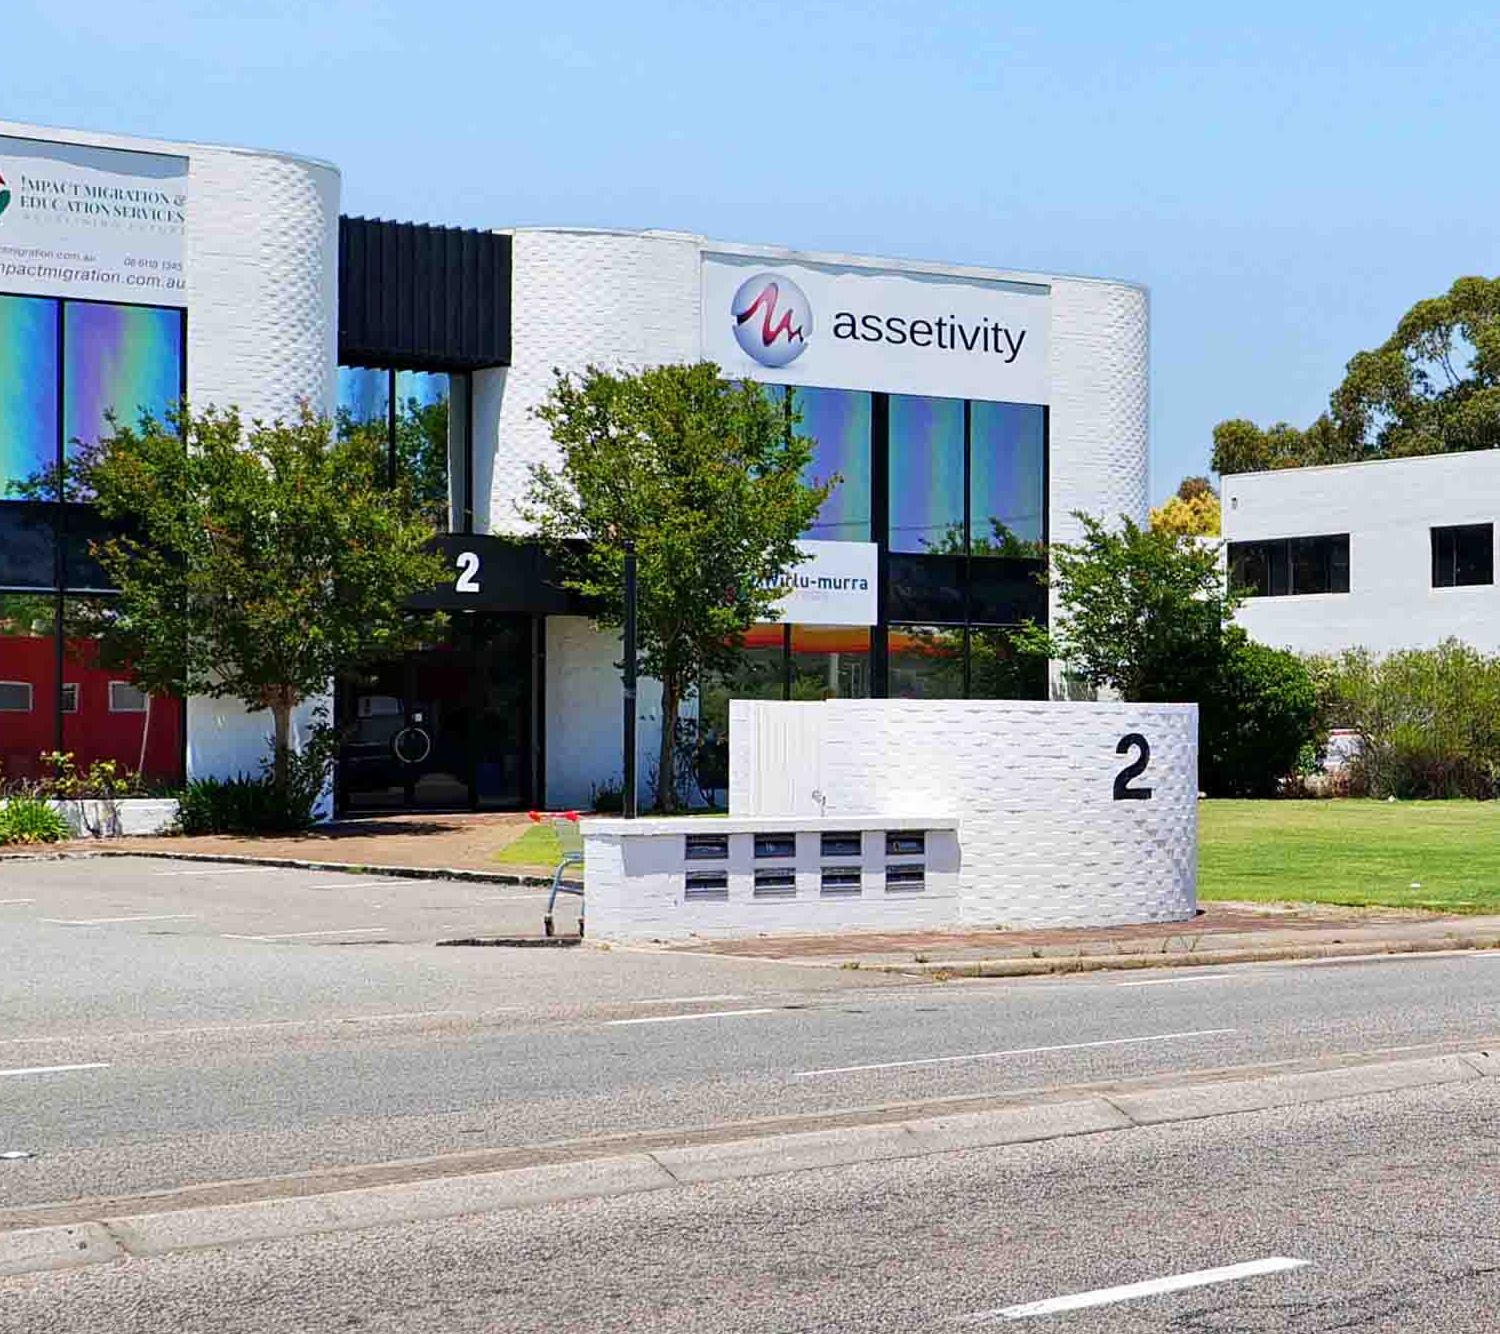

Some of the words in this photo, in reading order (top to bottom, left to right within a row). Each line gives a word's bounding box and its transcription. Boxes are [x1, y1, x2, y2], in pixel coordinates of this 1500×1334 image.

[20, 195, 110, 218] EDUCATION
[113, 204, 186, 224] SERVICES
[83, 182, 170, 205] MIGRATION
[832, 310, 1027, 364] assetivity
[456, 551, 480, 593] 2
[1113, 733, 1152, 801] 2
